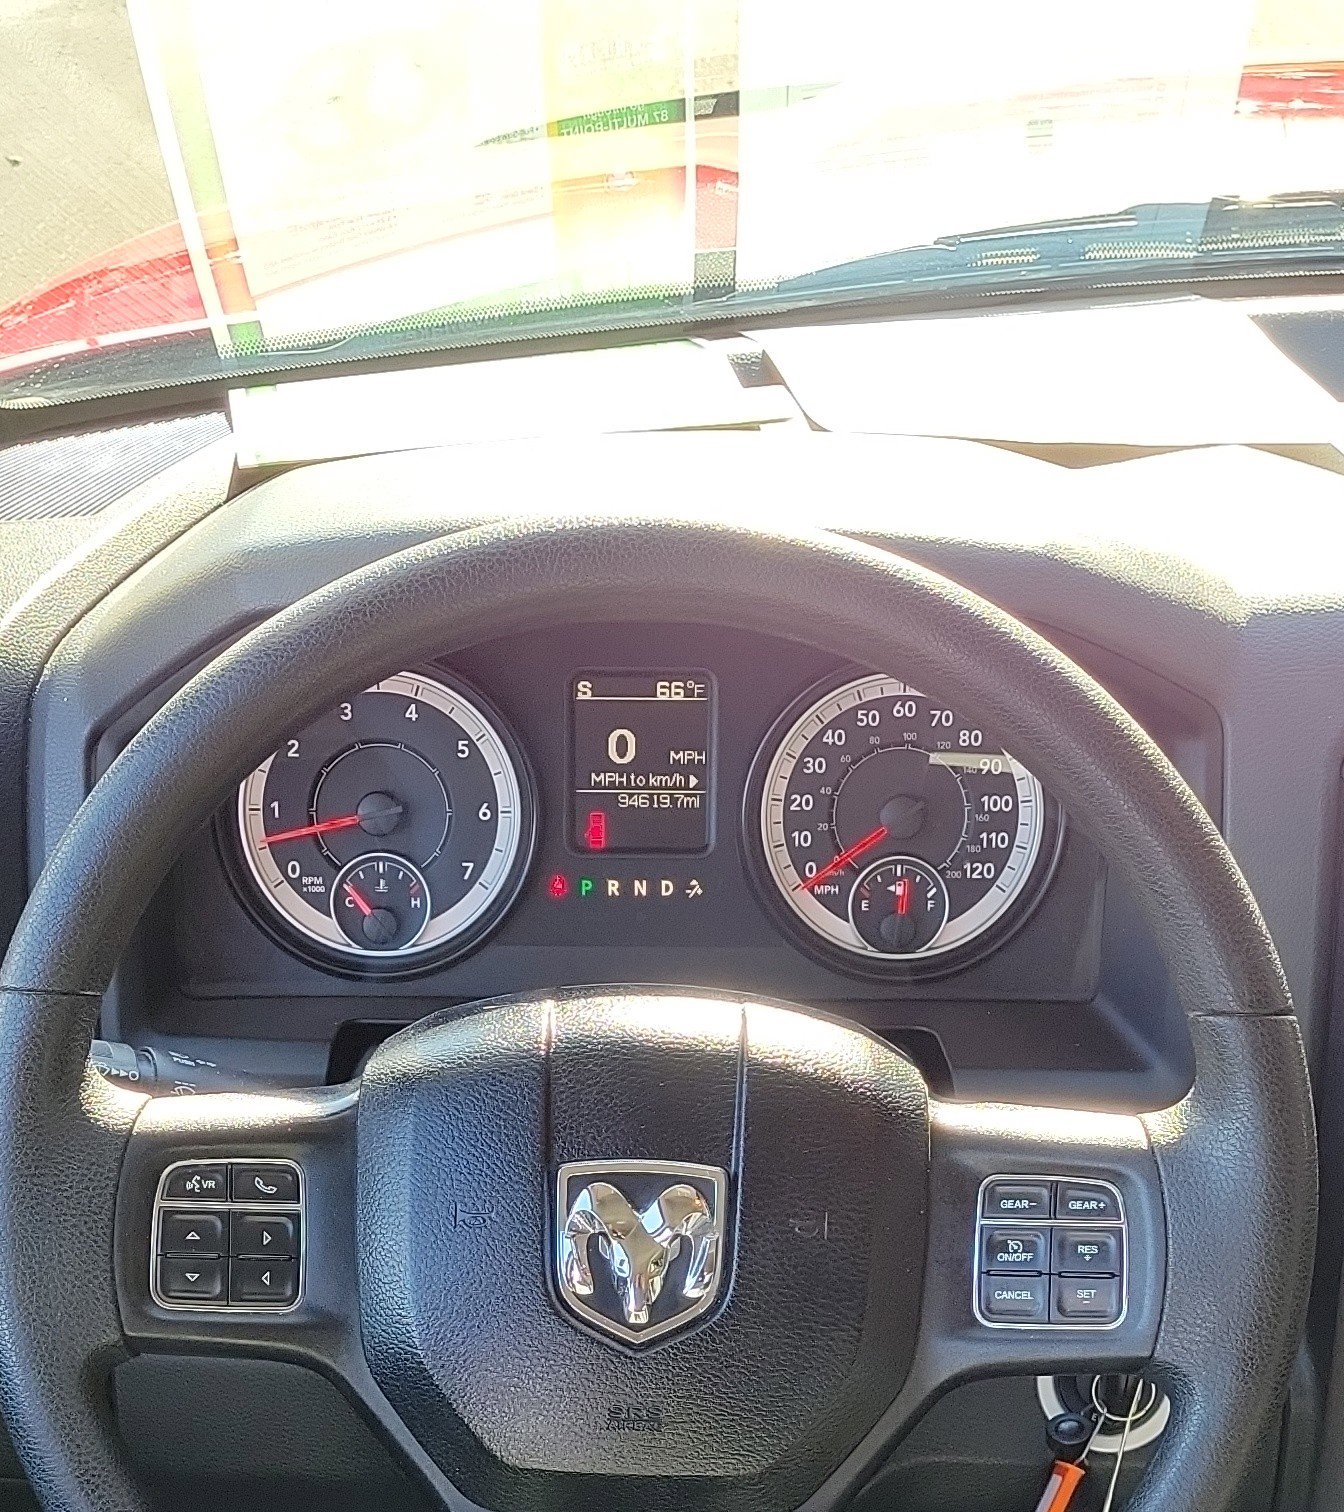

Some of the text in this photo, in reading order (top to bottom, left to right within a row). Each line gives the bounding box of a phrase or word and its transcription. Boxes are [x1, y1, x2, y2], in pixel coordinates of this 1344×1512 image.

[577, 680, 592, 698] S
[340, 702, 353, 721] 3
[405, 704, 418, 721] 4
[892, 701, 916, 718] 60
[857, 710, 880, 726] 50
[929, 710, 953, 727] 70
[822, 729, 846, 746] 40
[959, 730, 983, 747] 80
[287, 740, 299, 758] 2
[457, 741, 470, 758] 5
[608, 728, 706, 765] 0 MPH
[803, 758, 826, 774] 30
[979, 758, 1002, 775] 90
[591, 772, 685, 788] MPH to km/h
[270, 801, 279, 818] 1
[789, 795, 813, 811] 20
[981, 796, 1013, 812] 100
[478, 803, 491, 820] 6
[792, 831, 812, 847] 10
[979, 832, 1009, 848] 110
[287, 860, 300, 878] 0
[462, 862, 474, 880] 7
[805, 862, 817, 878] 0
[964, 863, 995, 879] 120
[302, 876, 323, 885] RPM
[581, 880, 674, 896] P R N D
[814, 884, 839, 895] MPH
[345, 897, 355, 908] C
[411, 898, 421, 908] H
[862, 901, 869, 911] E
[927, 901, 935, 911] F
[201, 1179, 216, 1188] VR
[997, 1253, 1034, 1262] ON/OFF
[1077, 1245, 1098, 1254] RES
[994, 1291, 1034, 1300] CANCEL
[1076, 1290, 1096, 1299] SET
